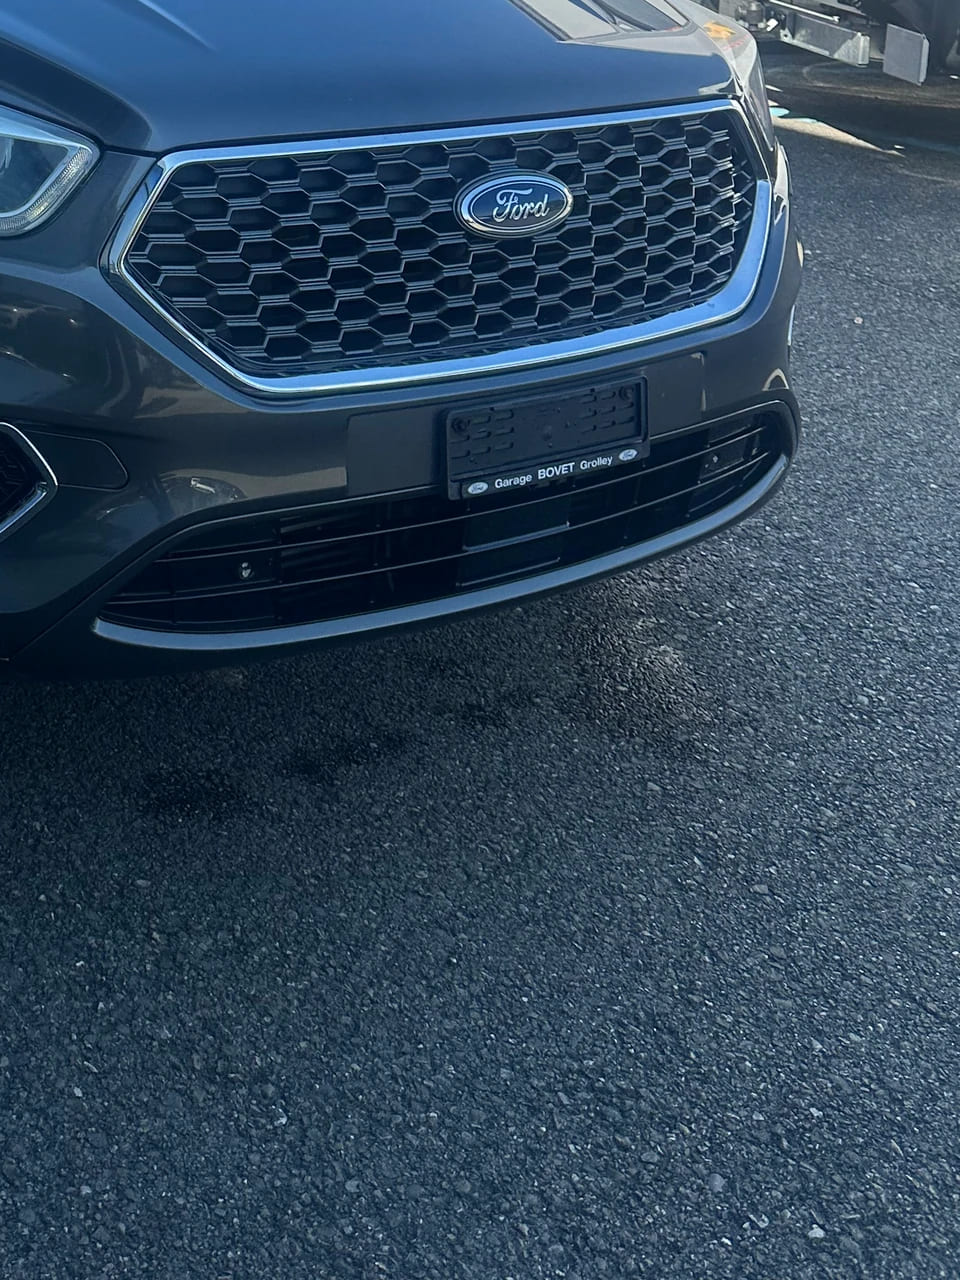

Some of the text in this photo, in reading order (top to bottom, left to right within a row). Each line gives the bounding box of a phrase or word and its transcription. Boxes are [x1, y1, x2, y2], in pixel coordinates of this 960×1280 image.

[492, 187, 550, 223] Ford
[494, 473, 533, 489] Garage
[537, 462, 576, 480] BOVET
[579, 455, 613, 470] Grolley
